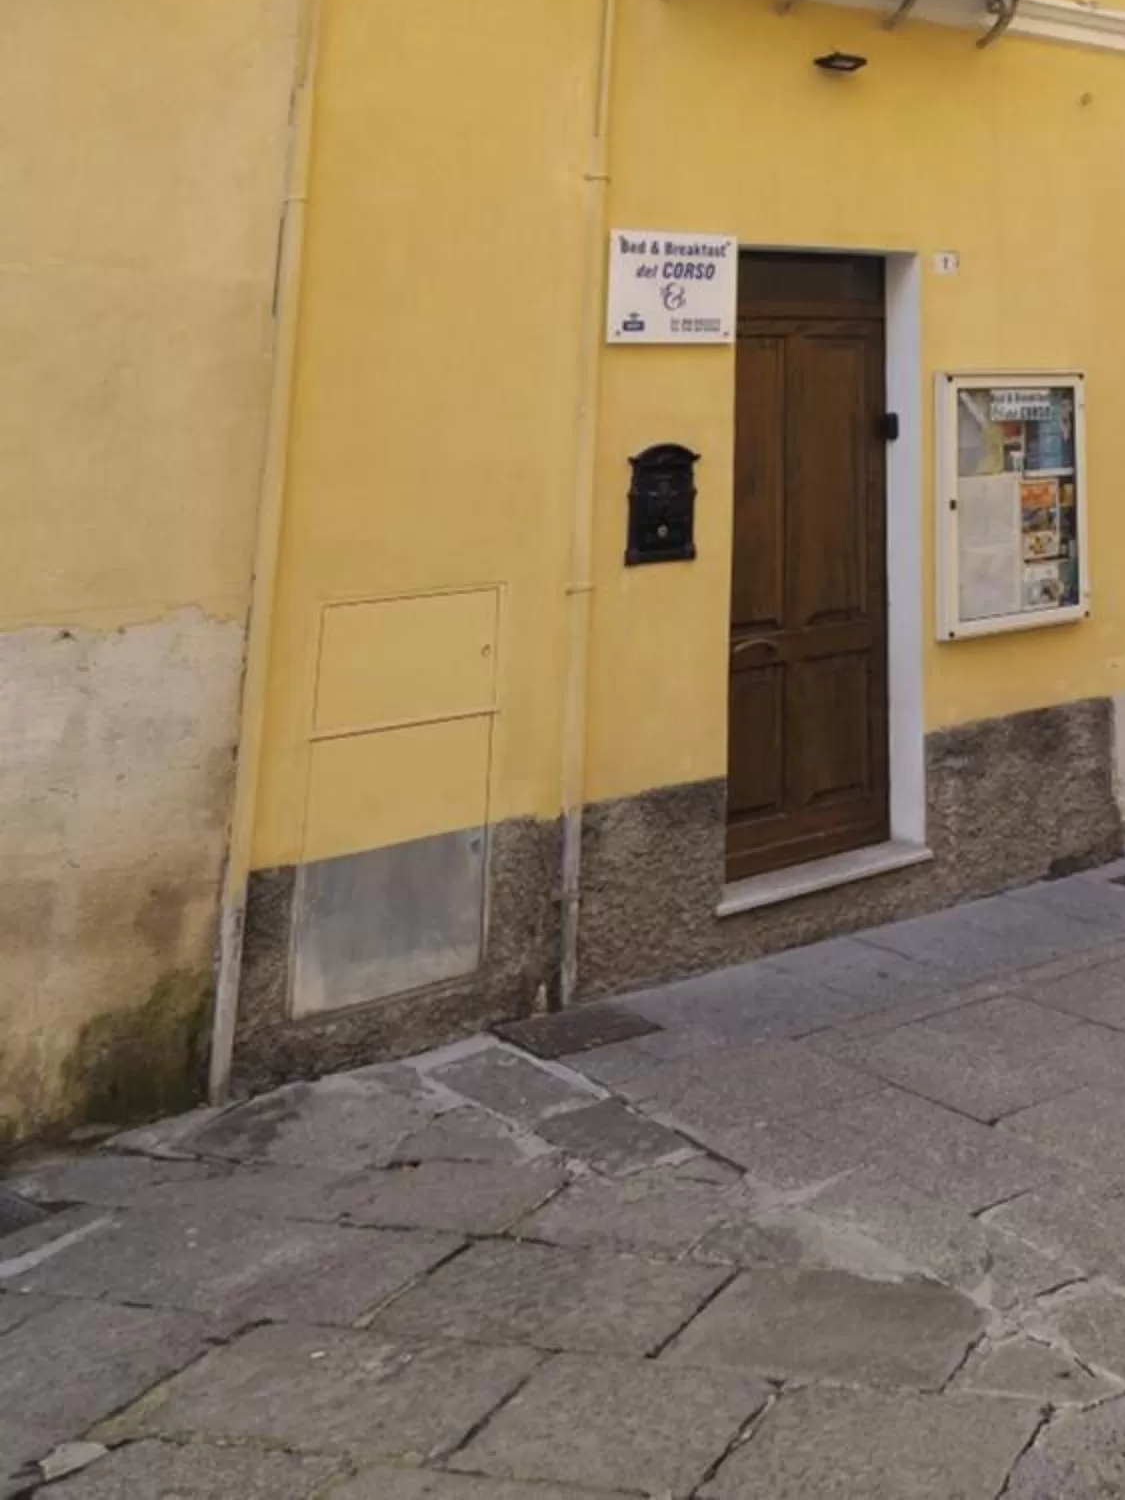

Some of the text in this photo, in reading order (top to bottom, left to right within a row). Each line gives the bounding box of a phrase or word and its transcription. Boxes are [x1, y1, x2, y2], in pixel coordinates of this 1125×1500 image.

[620, 239, 727, 258] Bed & Breakfast
[636, 262, 716, 280] del CORSO
